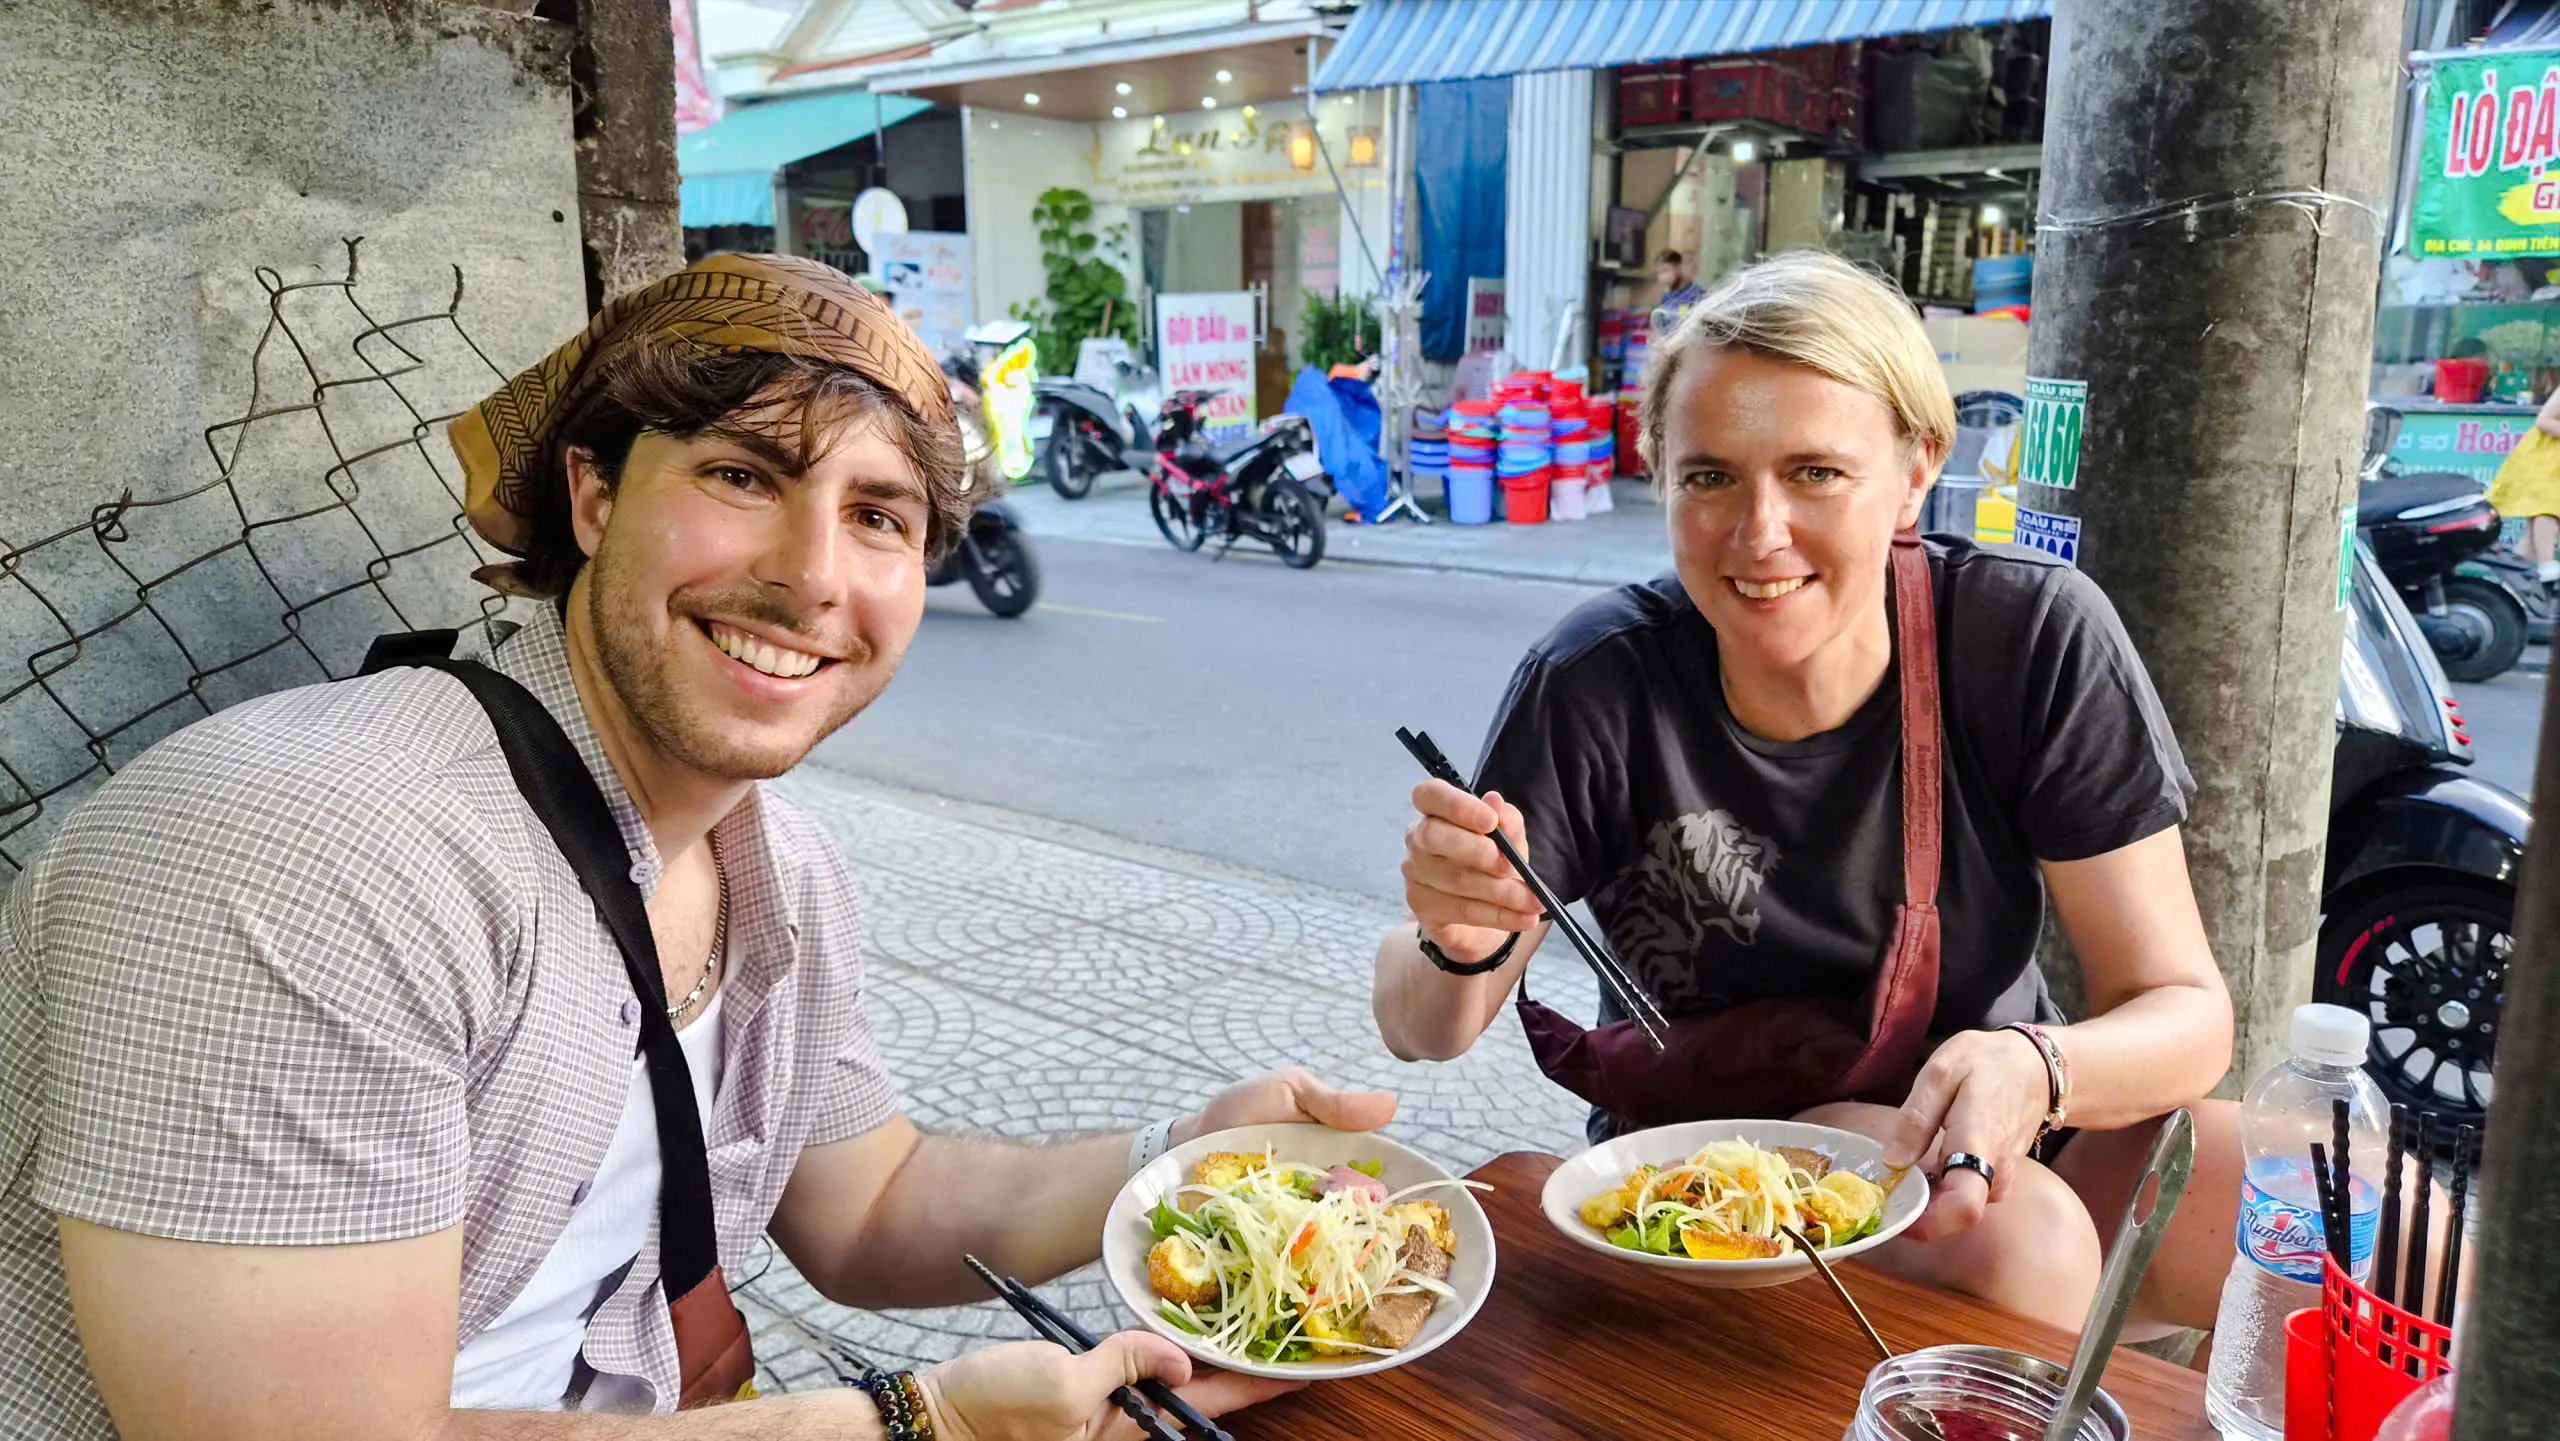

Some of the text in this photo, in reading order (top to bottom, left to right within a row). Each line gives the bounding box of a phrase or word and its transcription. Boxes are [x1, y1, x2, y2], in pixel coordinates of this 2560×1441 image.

[2446, 68, 2560, 178] LÒ ĐẬ
[2532, 182, 2560, 210] G
[2245, 1208, 2325, 1248] Number
